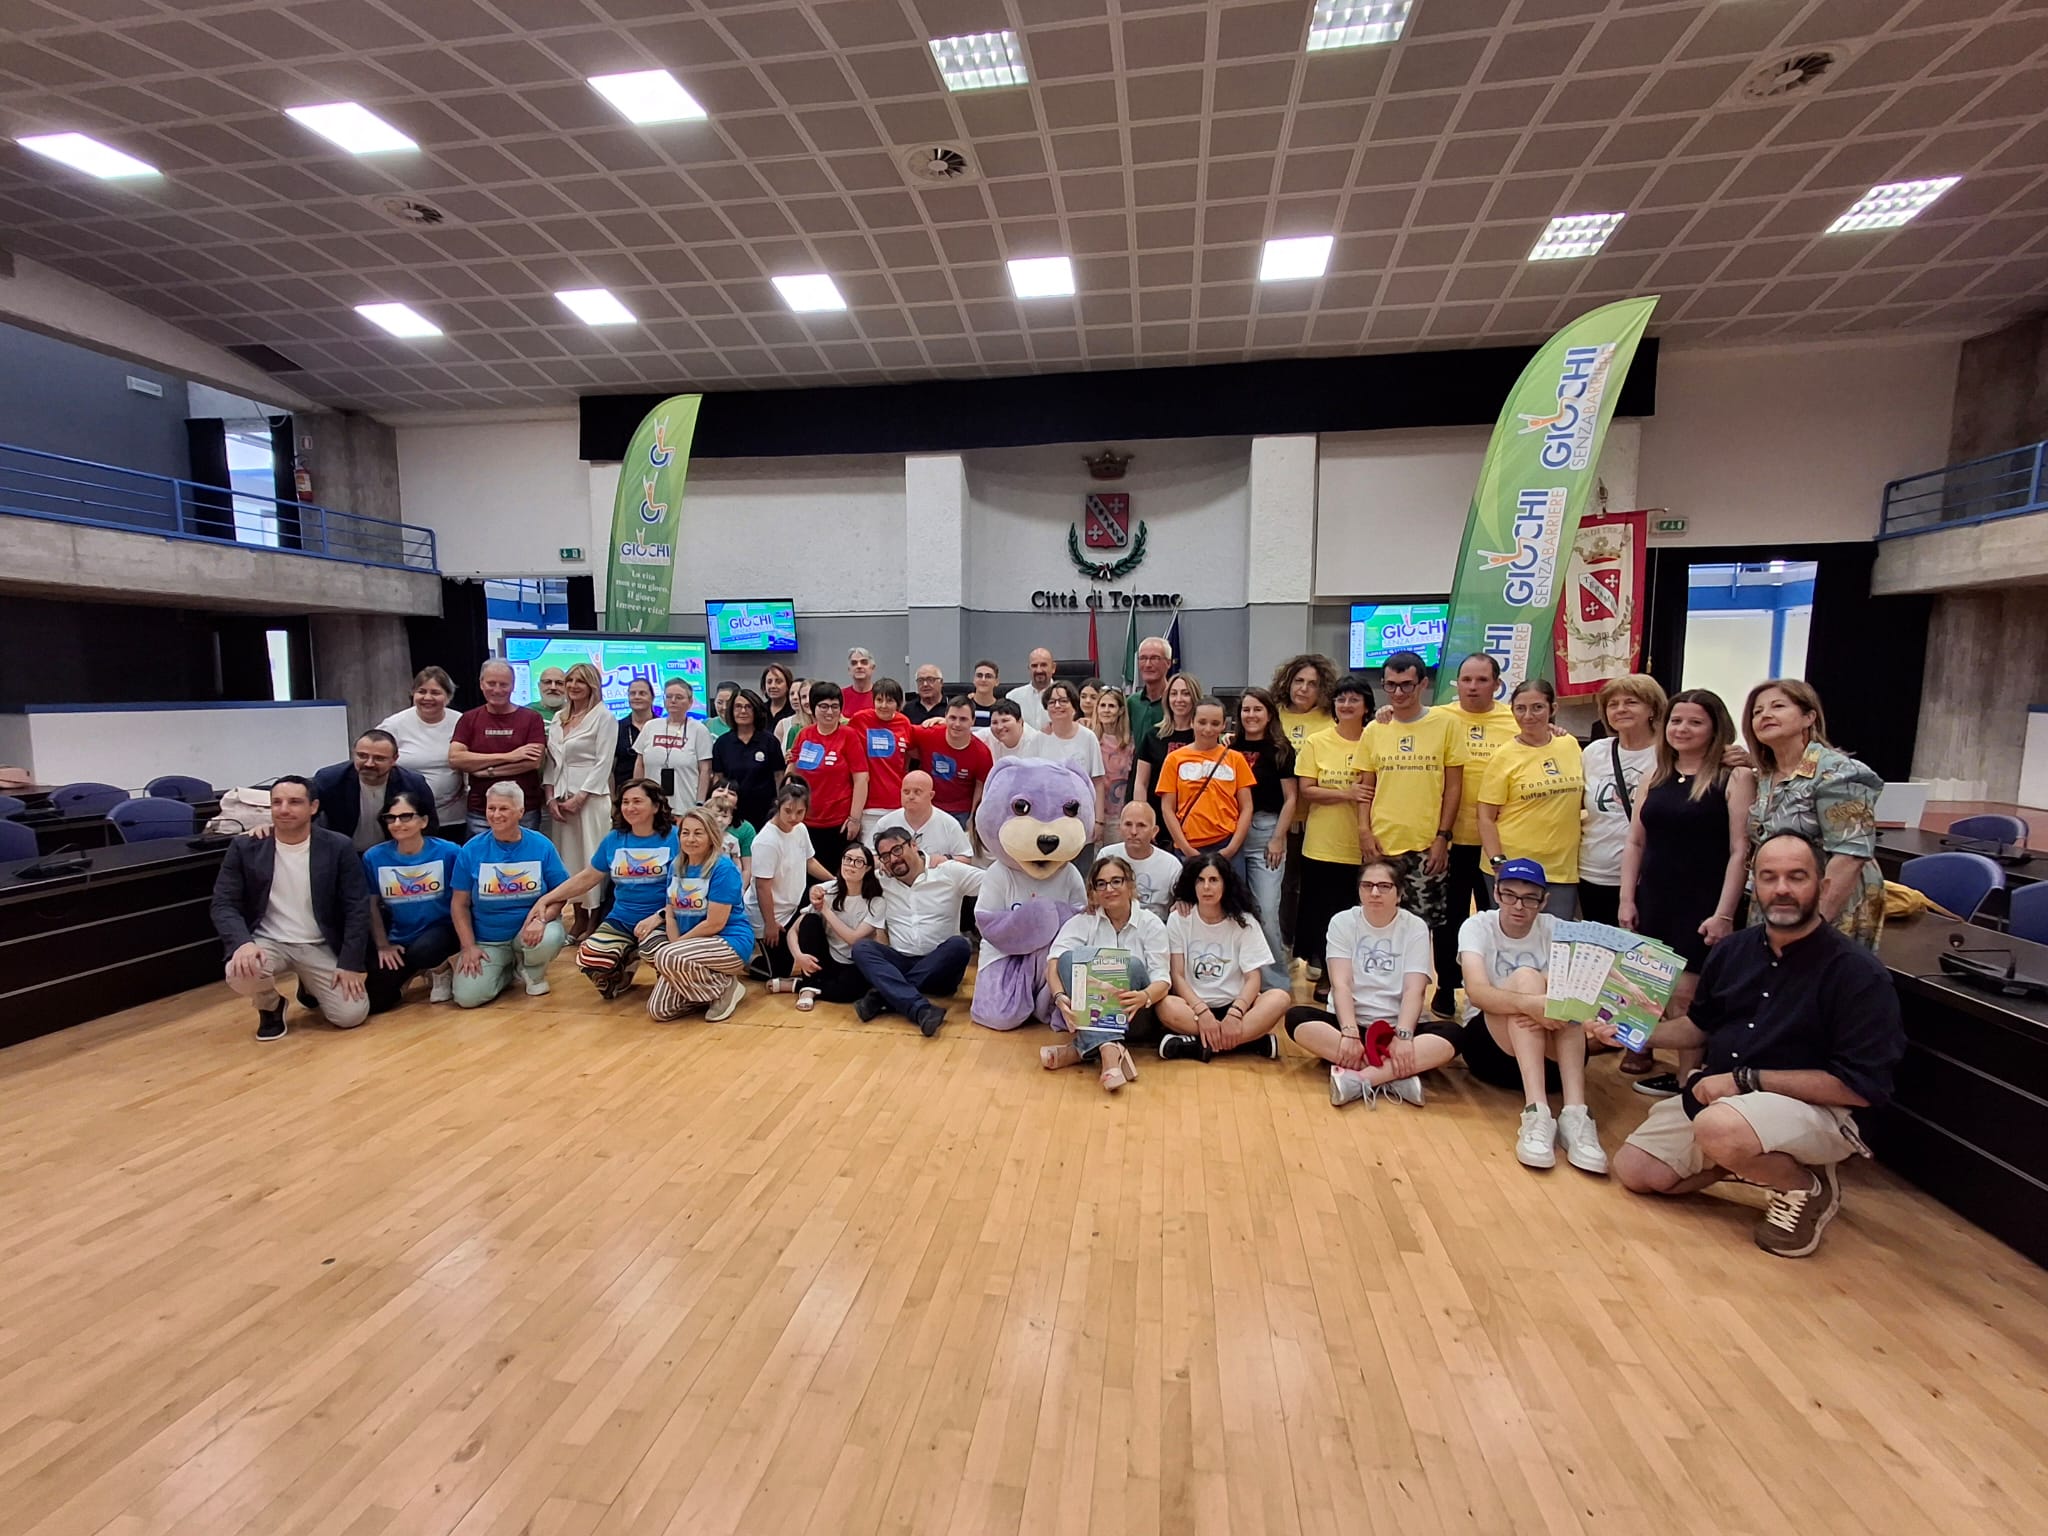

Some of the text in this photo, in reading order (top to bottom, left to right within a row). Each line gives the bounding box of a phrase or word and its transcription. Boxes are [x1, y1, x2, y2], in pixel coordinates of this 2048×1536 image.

[1542, 348, 1598, 468] GIOCHI
[621, 542, 670, 558] GIOCHI
[1505, 491, 1549, 605] GIOCHI
[1534, 489, 1564, 604] SENZABARRIERE
[1031, 588, 1078, 609] Città
[729, 615, 772, 629] GIOCHI
[614, 865, 663, 876] IL VOLO
[385, 880, 441, 897] IL VOLO
[483, 880, 538, 894] IL VOLO
[675, 898, 703, 909] VOLO
[1624, 950, 1675, 976] GIOCHI
